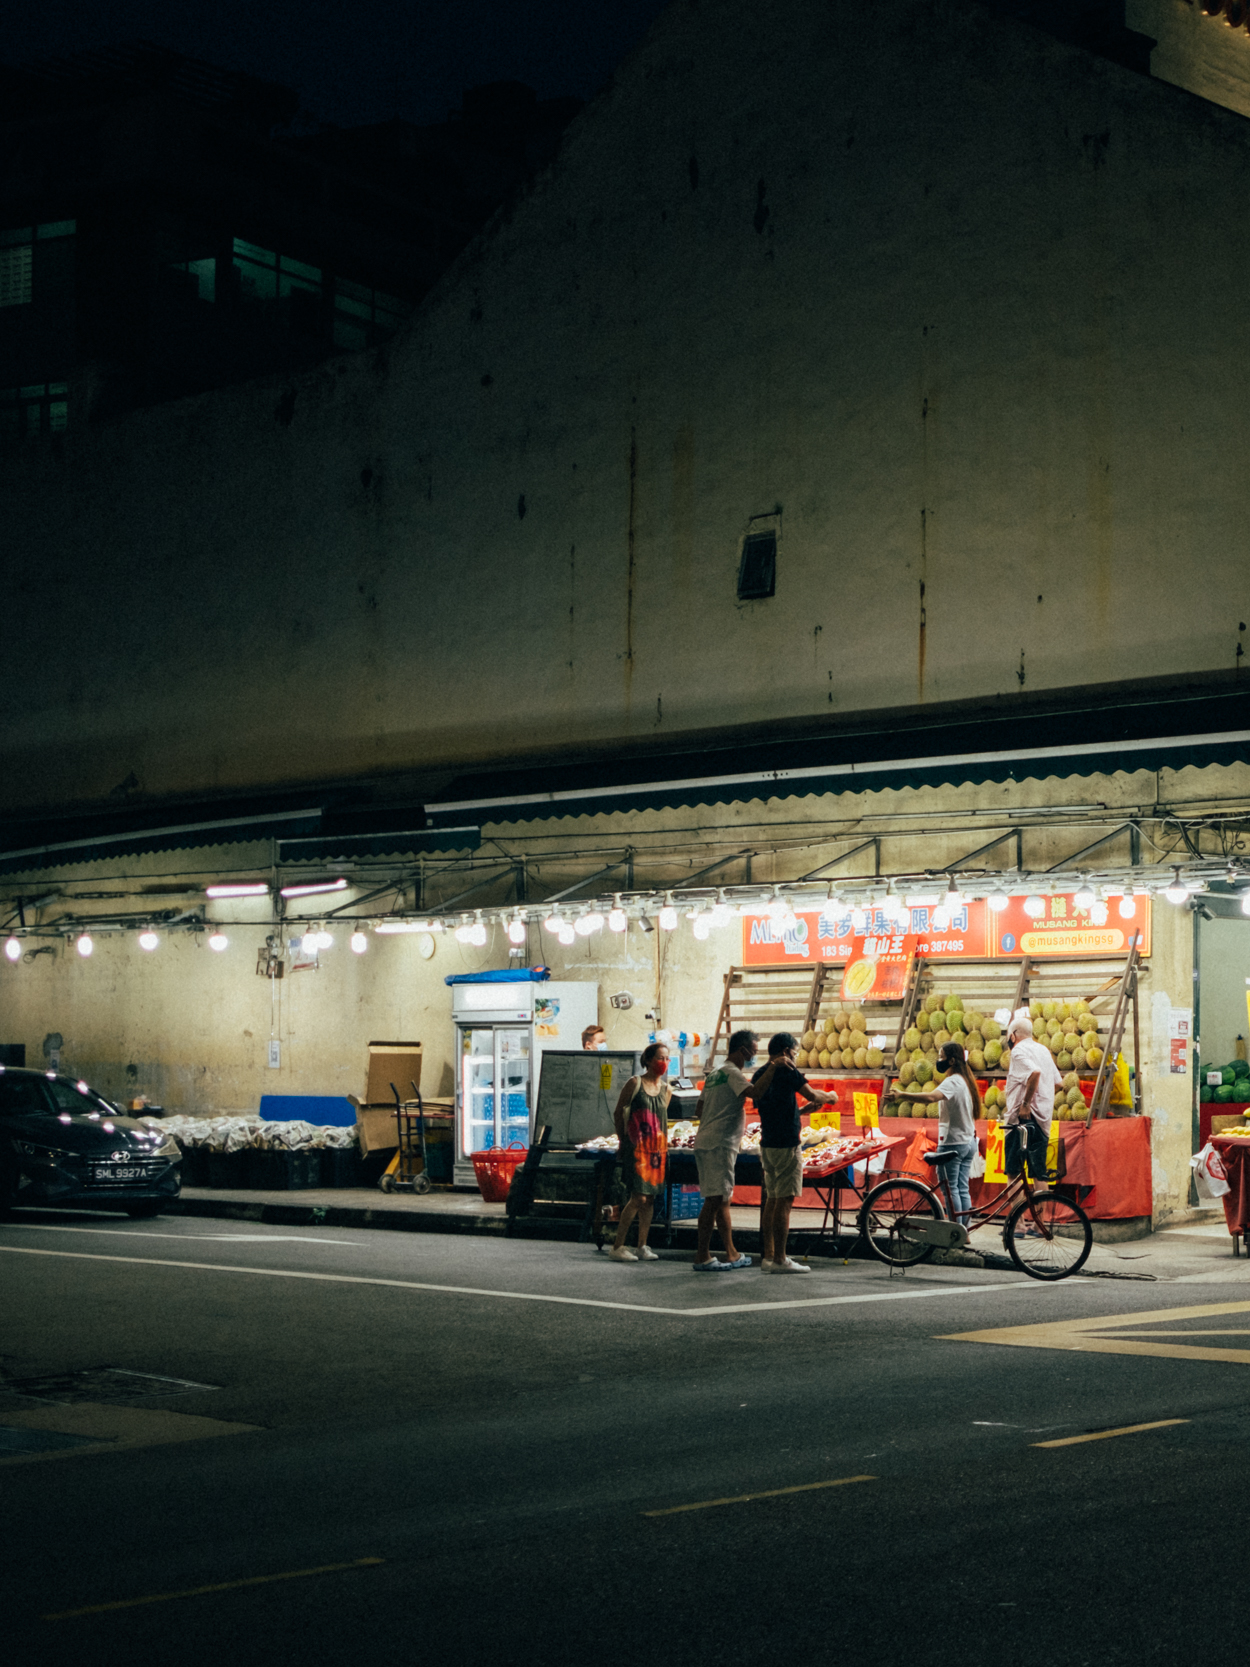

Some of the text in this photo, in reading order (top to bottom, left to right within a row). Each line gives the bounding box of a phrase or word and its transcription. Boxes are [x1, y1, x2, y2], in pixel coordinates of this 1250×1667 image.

[1033, 920, 1077, 929] MUSANG
[931, 940, 964, 952] 387495
[1028, 934, 1114, 949] @musangkingsg
[822, 946, 836, 957] 183
